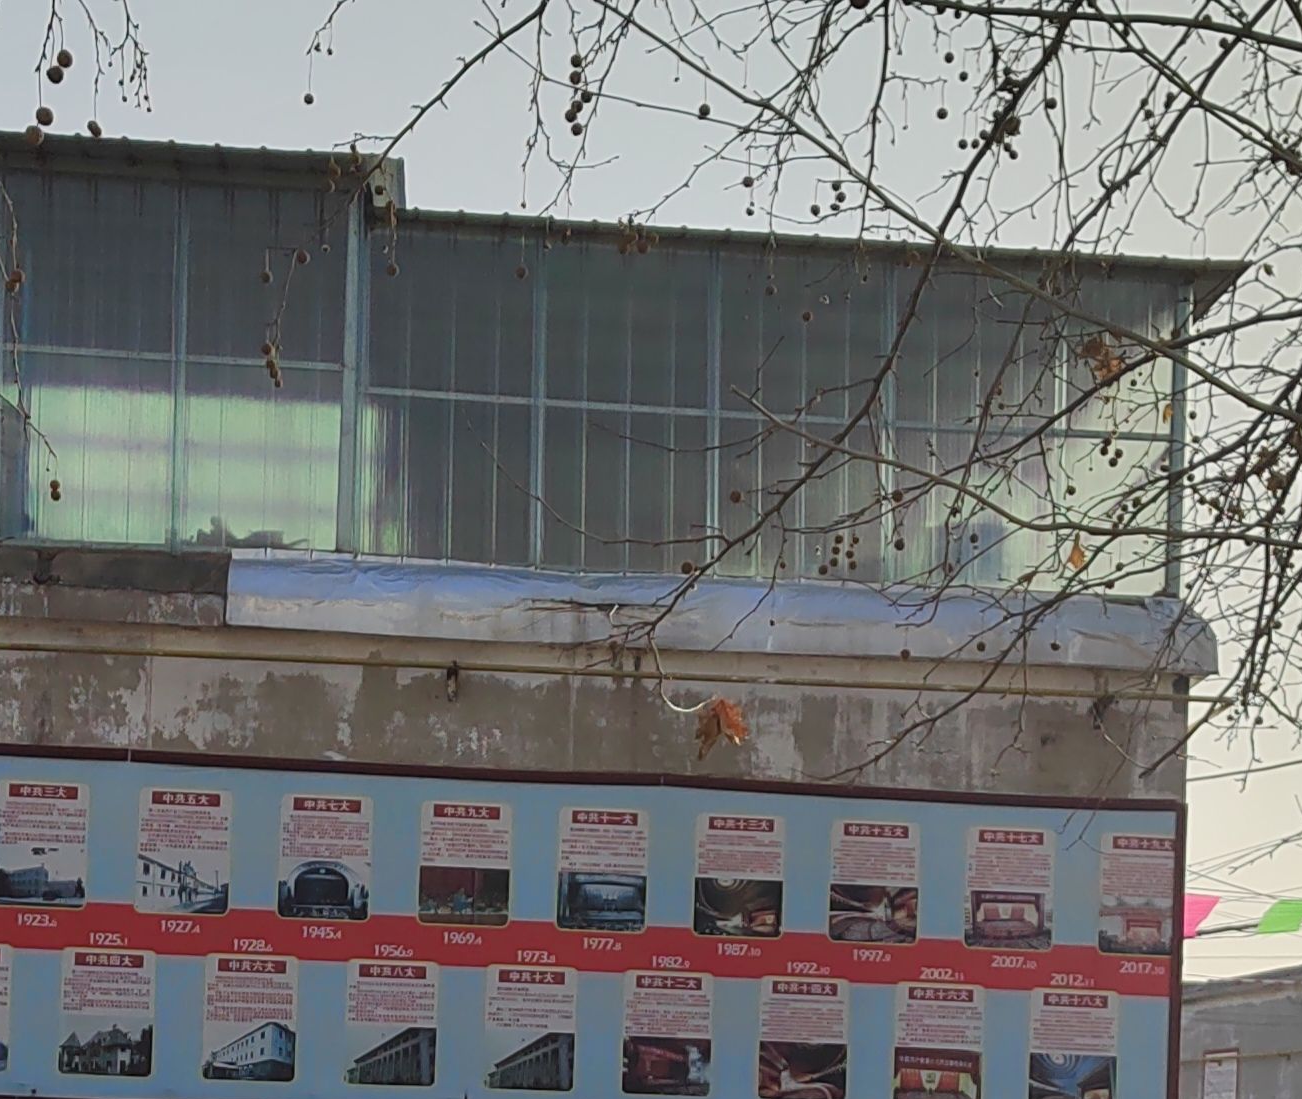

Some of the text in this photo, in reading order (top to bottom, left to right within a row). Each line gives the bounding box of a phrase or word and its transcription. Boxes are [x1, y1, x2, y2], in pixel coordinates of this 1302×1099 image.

[19, 784, 67, 798] 中共三大
[163, 792, 209, 805] 中共五大
[303, 799, 350, 812] 中共七大
[443, 806, 490, 819] 中共九大
[576, 812, 634, 825] 中共十一大
[713, 818, 770, 832] 中共十三大
[848, 825, 905, 838] 中共十五大
[983, 831, 1040, 844] 中共十七大
[89, 932, 128, 946] 1925.1
[302, 926, 342, 939] 1945.4
[717, 943, 761, 957] 1987.10
[852, 949, 891, 962] 1997.9
[85, 954, 133, 967] 中共四大
[229, 961, 276, 972] 中共六大
[651, 955, 690, 969] 1982.9
[991, 955, 1037, 969] 2007.10
[369, 966, 415, 978] 中共八大
[786, 961, 830, 975] 1992.10
[919, 967, 964, 981] 2002.11
[1119, 961, 1165, 975] 2017.10
[509, 971, 555, 983] 中共十大
[641, 977, 699, 989] 中共十二大
[1050, 973, 1095, 987] 2012.11
[777, 983, 833, 995] 中共十四大
[913, 988, 970, 1001] 中共十六大
[1047, 994, 1104, 1007] 中共十八大
